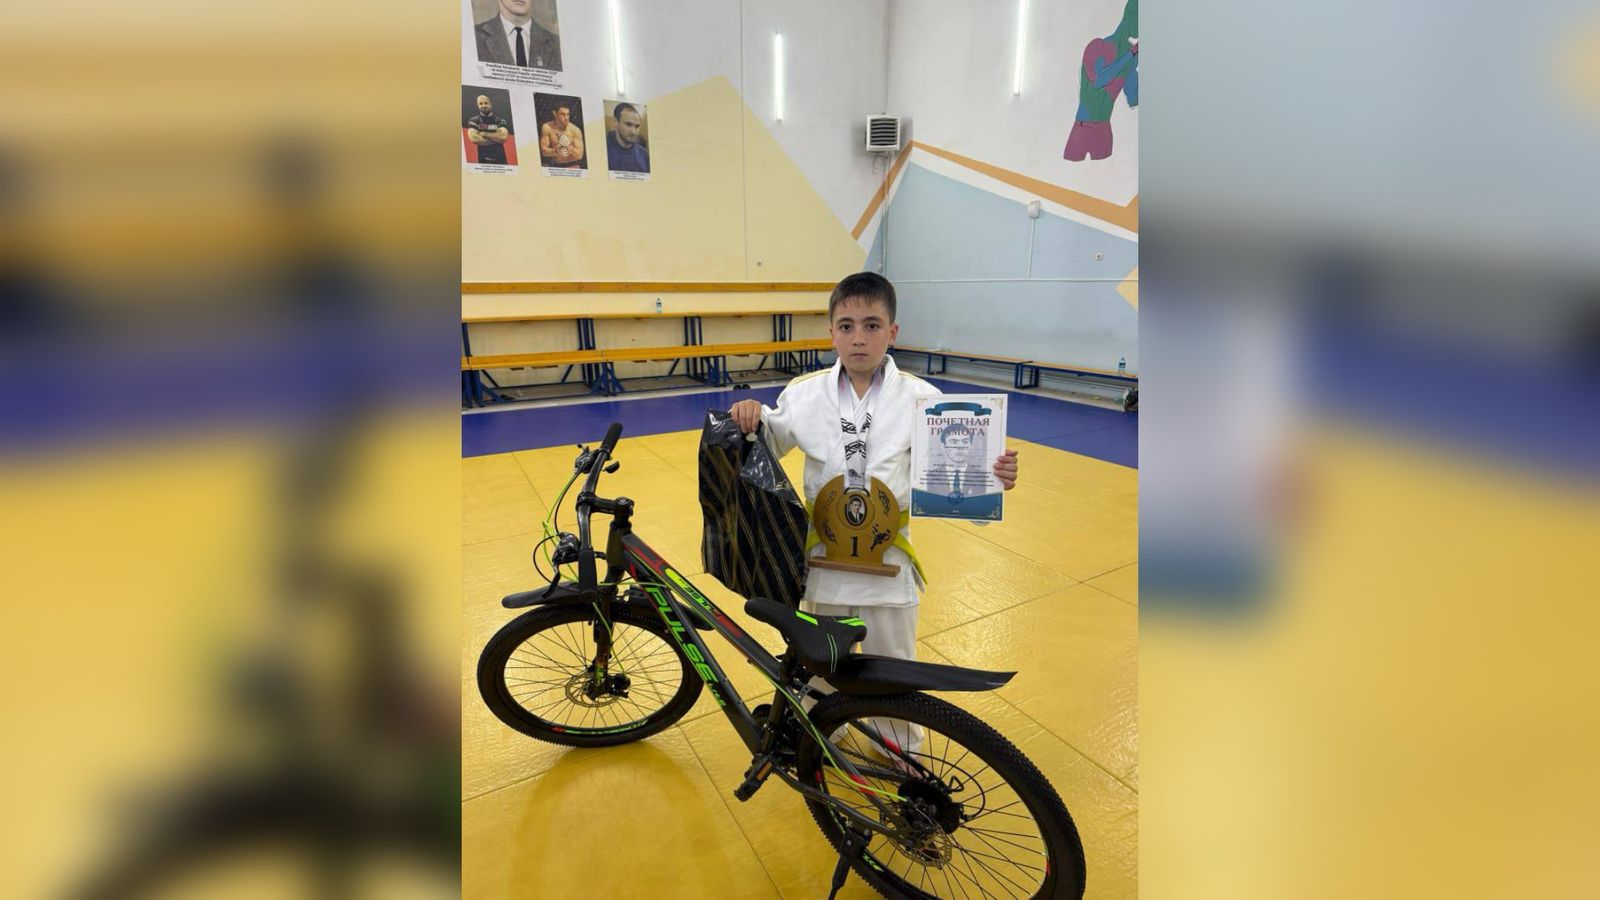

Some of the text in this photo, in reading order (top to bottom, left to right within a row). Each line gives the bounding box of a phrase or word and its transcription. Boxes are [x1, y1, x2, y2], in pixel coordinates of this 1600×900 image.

[927, 417, 990, 426] ПОЧЕТНАЯ
[930, 427, 985, 436] ГРАМОТА
[849, 535, 860, 557] 1
[645, 586, 719, 684] PULSE
